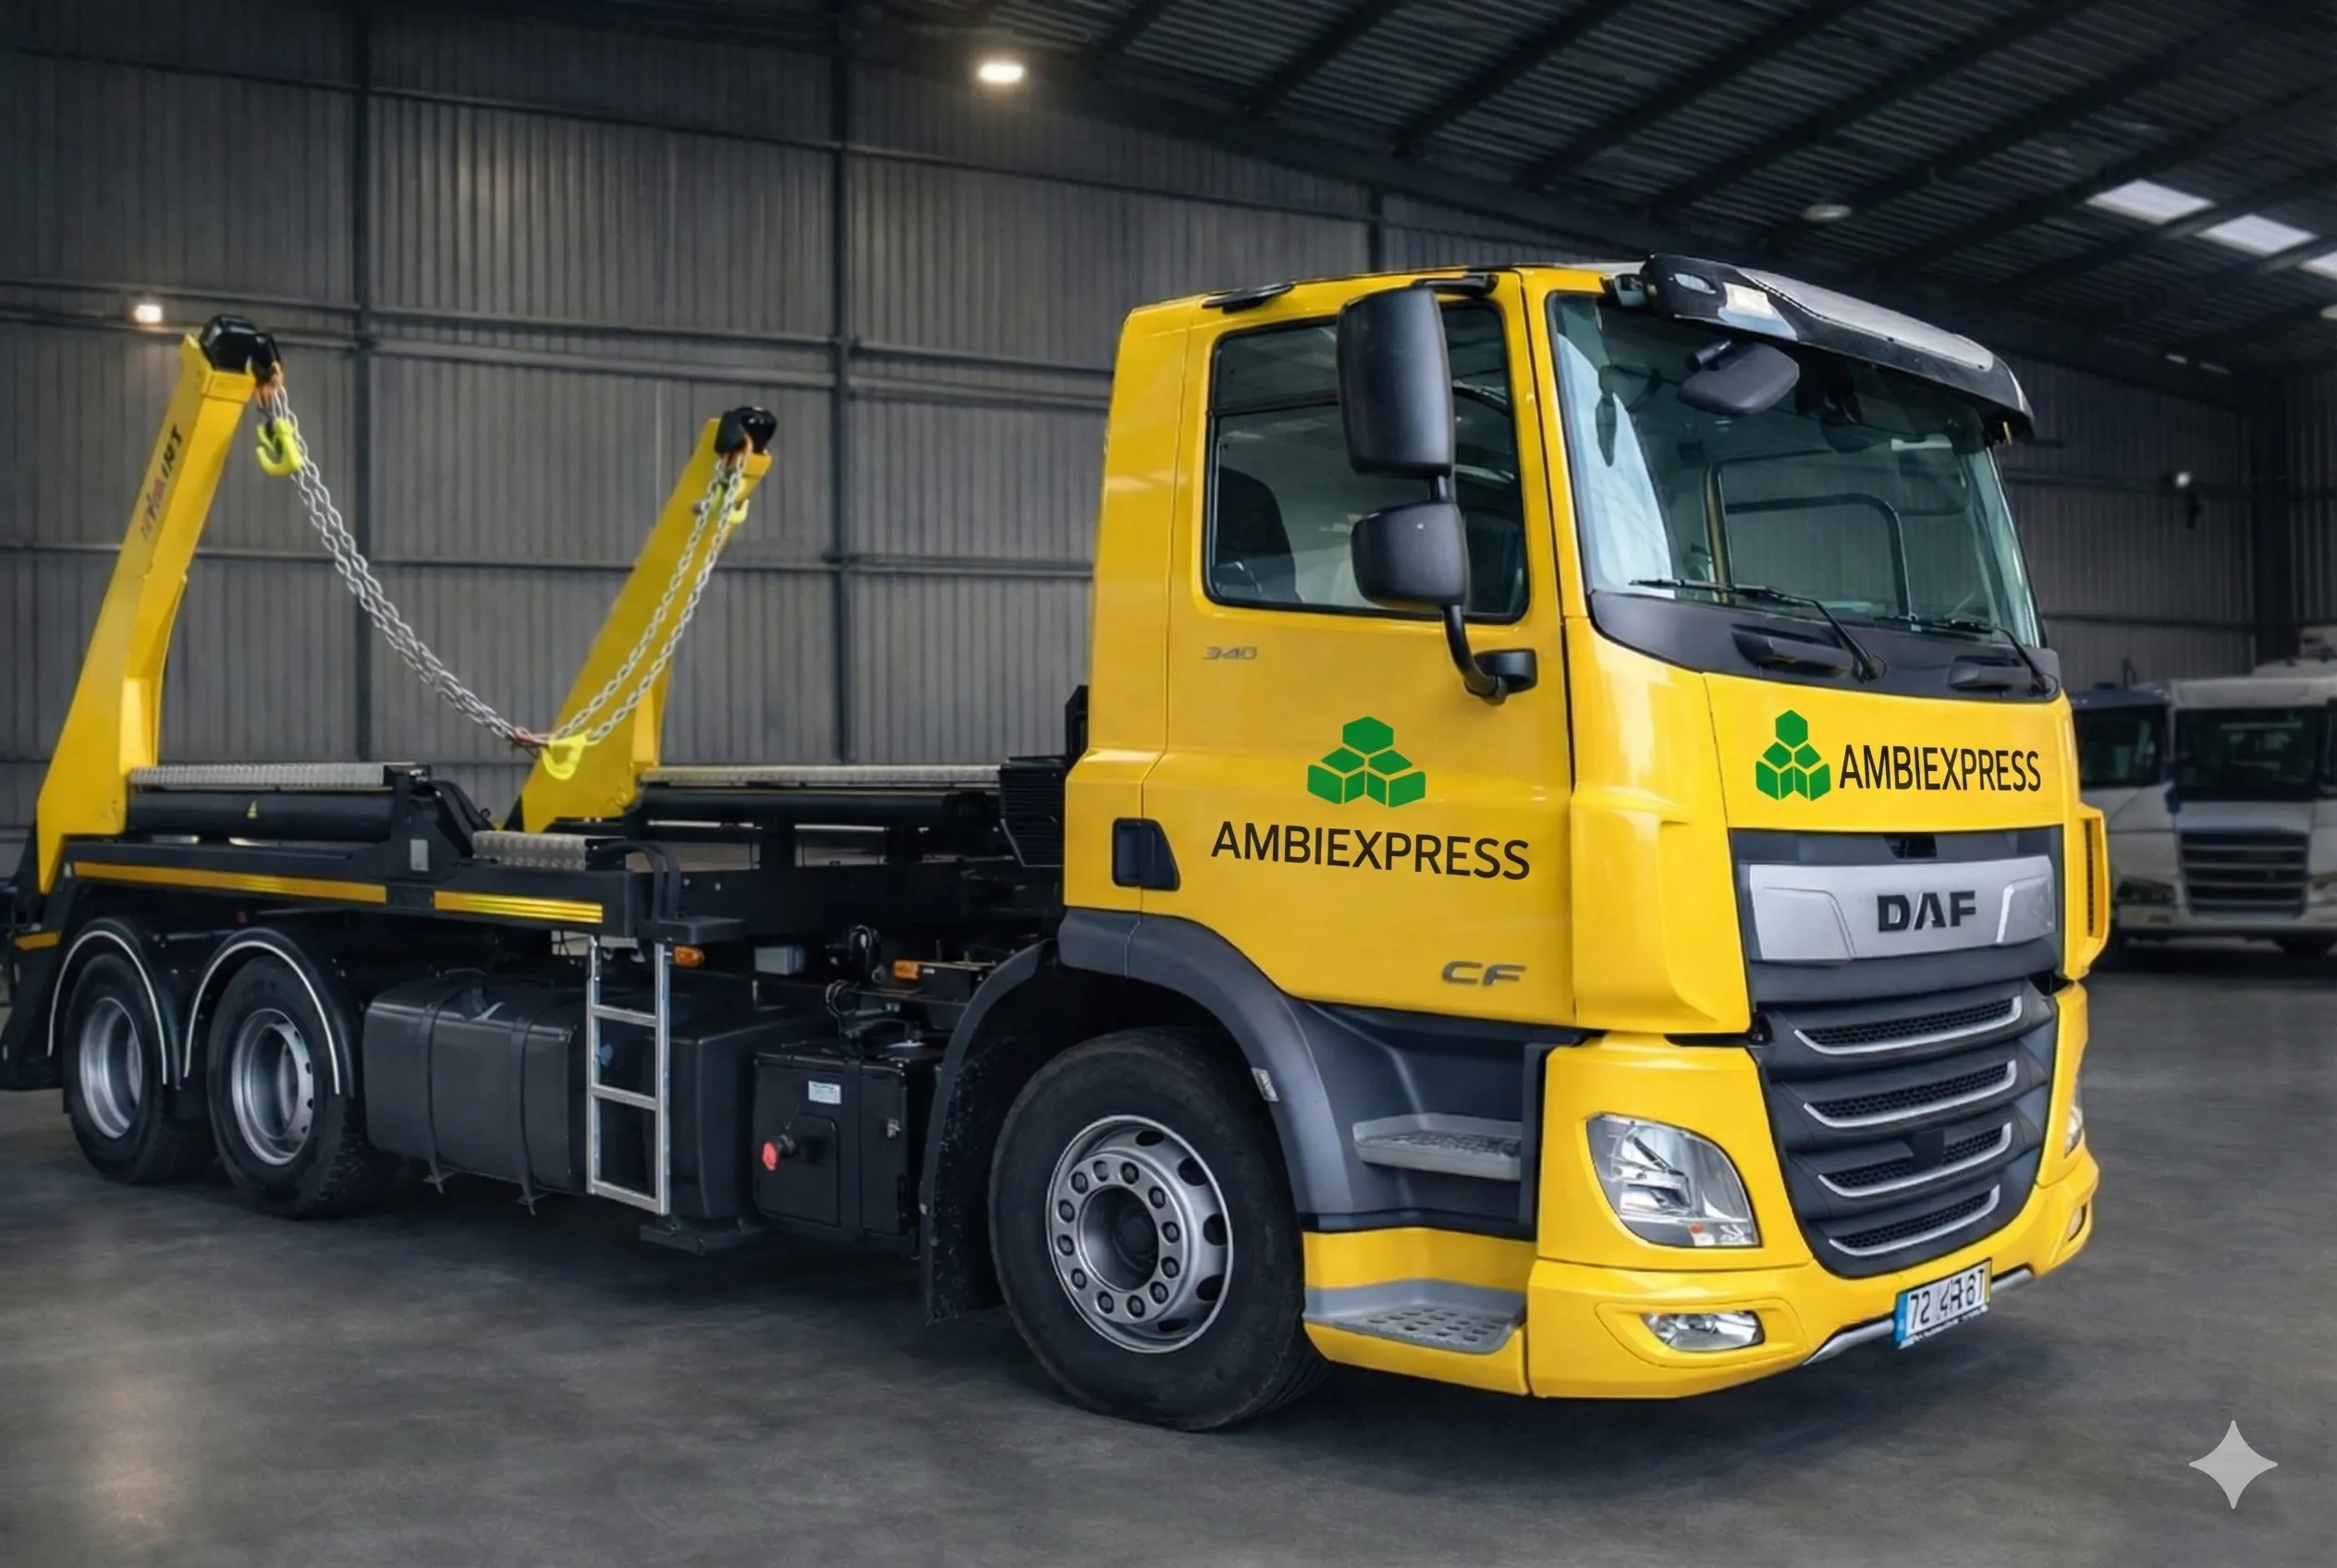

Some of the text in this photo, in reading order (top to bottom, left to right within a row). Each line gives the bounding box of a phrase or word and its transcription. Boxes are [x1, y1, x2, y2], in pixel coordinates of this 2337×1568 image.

[1202, 645, 1257, 661] 340
[1839, 743, 2042, 792] AMBIEXPRESS
[1211, 820, 1531, 880] AMBIEXPRESS
[1877, 890, 1976, 933] DAF
[1441, 960, 1527, 986] CF
